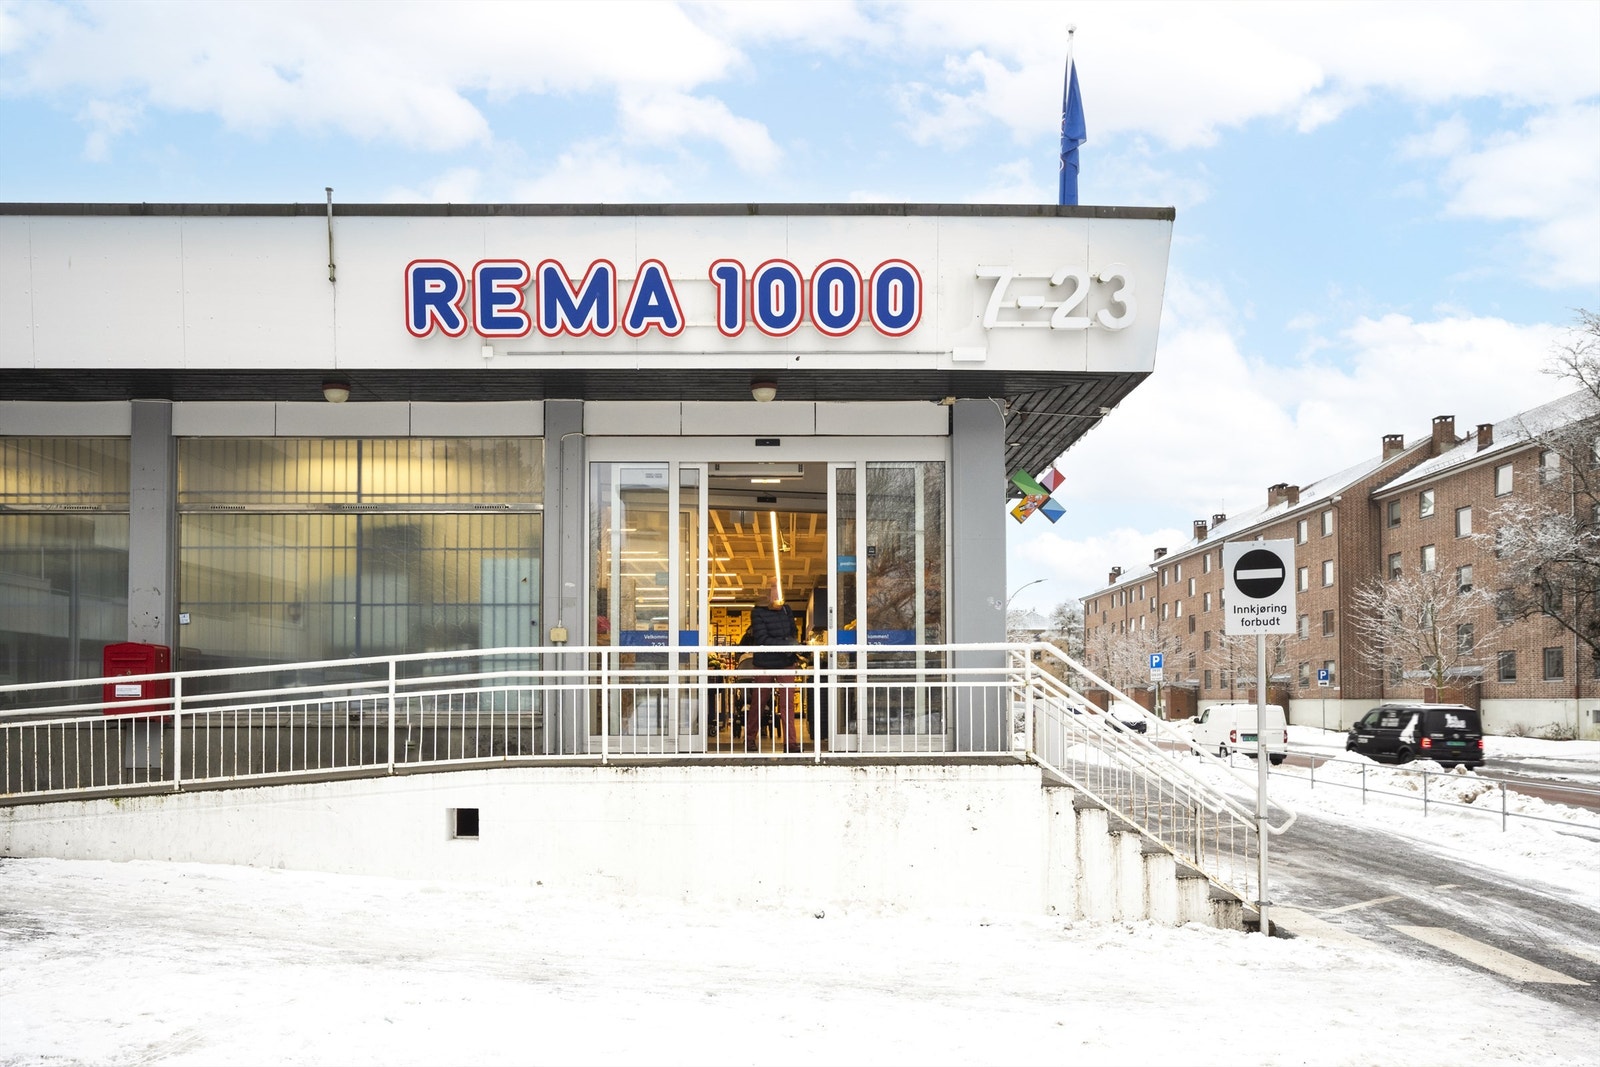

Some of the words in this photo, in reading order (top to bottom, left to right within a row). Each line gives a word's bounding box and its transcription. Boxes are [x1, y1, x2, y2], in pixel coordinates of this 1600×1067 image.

[405, 259, 685, 338] REMA
[709, 259, 923, 338] 1000
[976, 263, 1137, 331] 7-23
[1233, 604, 1287, 615] Innkjøring
[1241, 617, 1280, 627] forbudt
[1152, 655, 1160, 667] P
